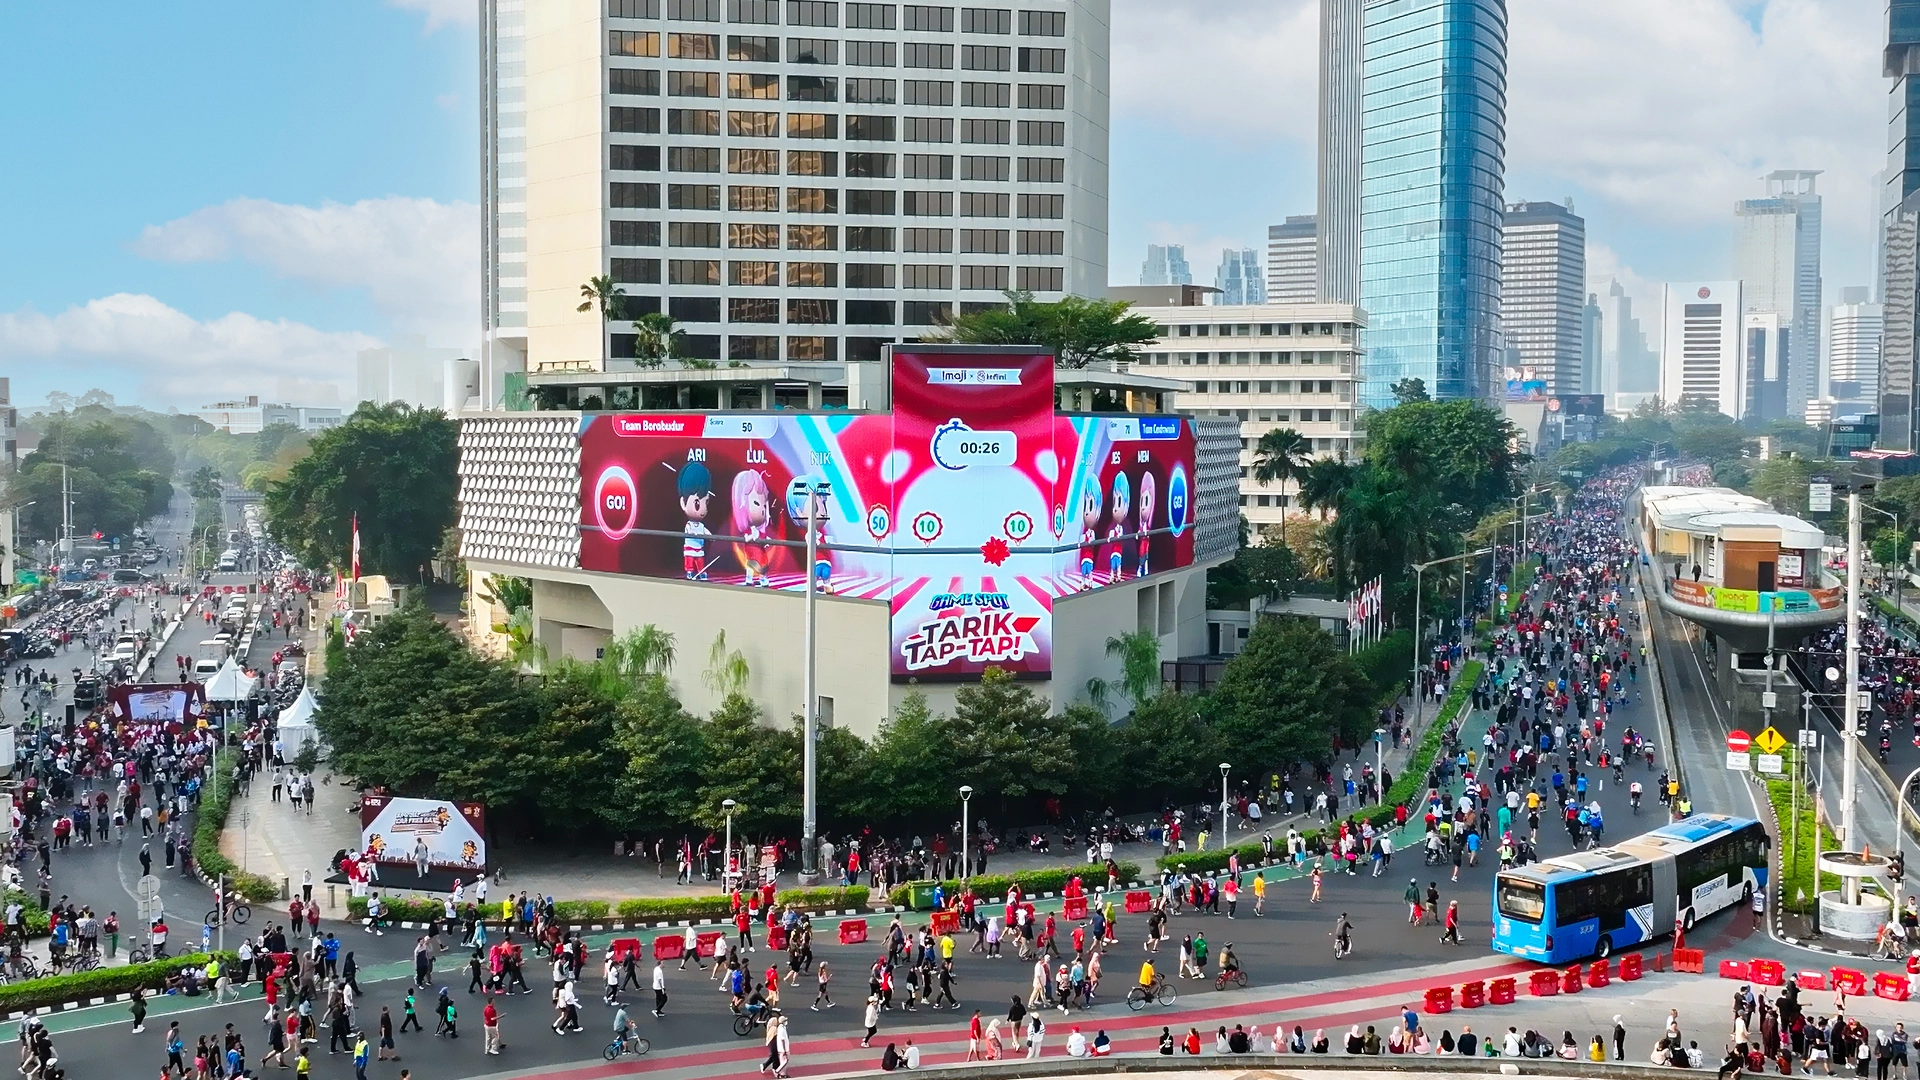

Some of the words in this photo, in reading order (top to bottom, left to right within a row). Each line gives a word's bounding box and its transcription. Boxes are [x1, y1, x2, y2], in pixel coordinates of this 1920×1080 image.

[620, 420, 642, 432] Team
[642, 420, 685, 432] Borobudur
[741, 422, 753, 433] 50
[687, 448, 706, 462] ARI
[959, 442, 1000, 455] 00:26
[746, 450, 768, 464] LUL
[810, 450, 832, 466] NIK
[606, 494, 627, 511] GO!
[872, 515, 886, 530] 50
[919, 520, 936, 533] 10
[1010, 520, 1026, 533] 10
[929, 593, 973, 611] GAME
[974, 593, 1010, 609] SPOT
[922, 611, 1014, 645] TARIK
[904, 635, 1021, 665] TAP-TAP!
